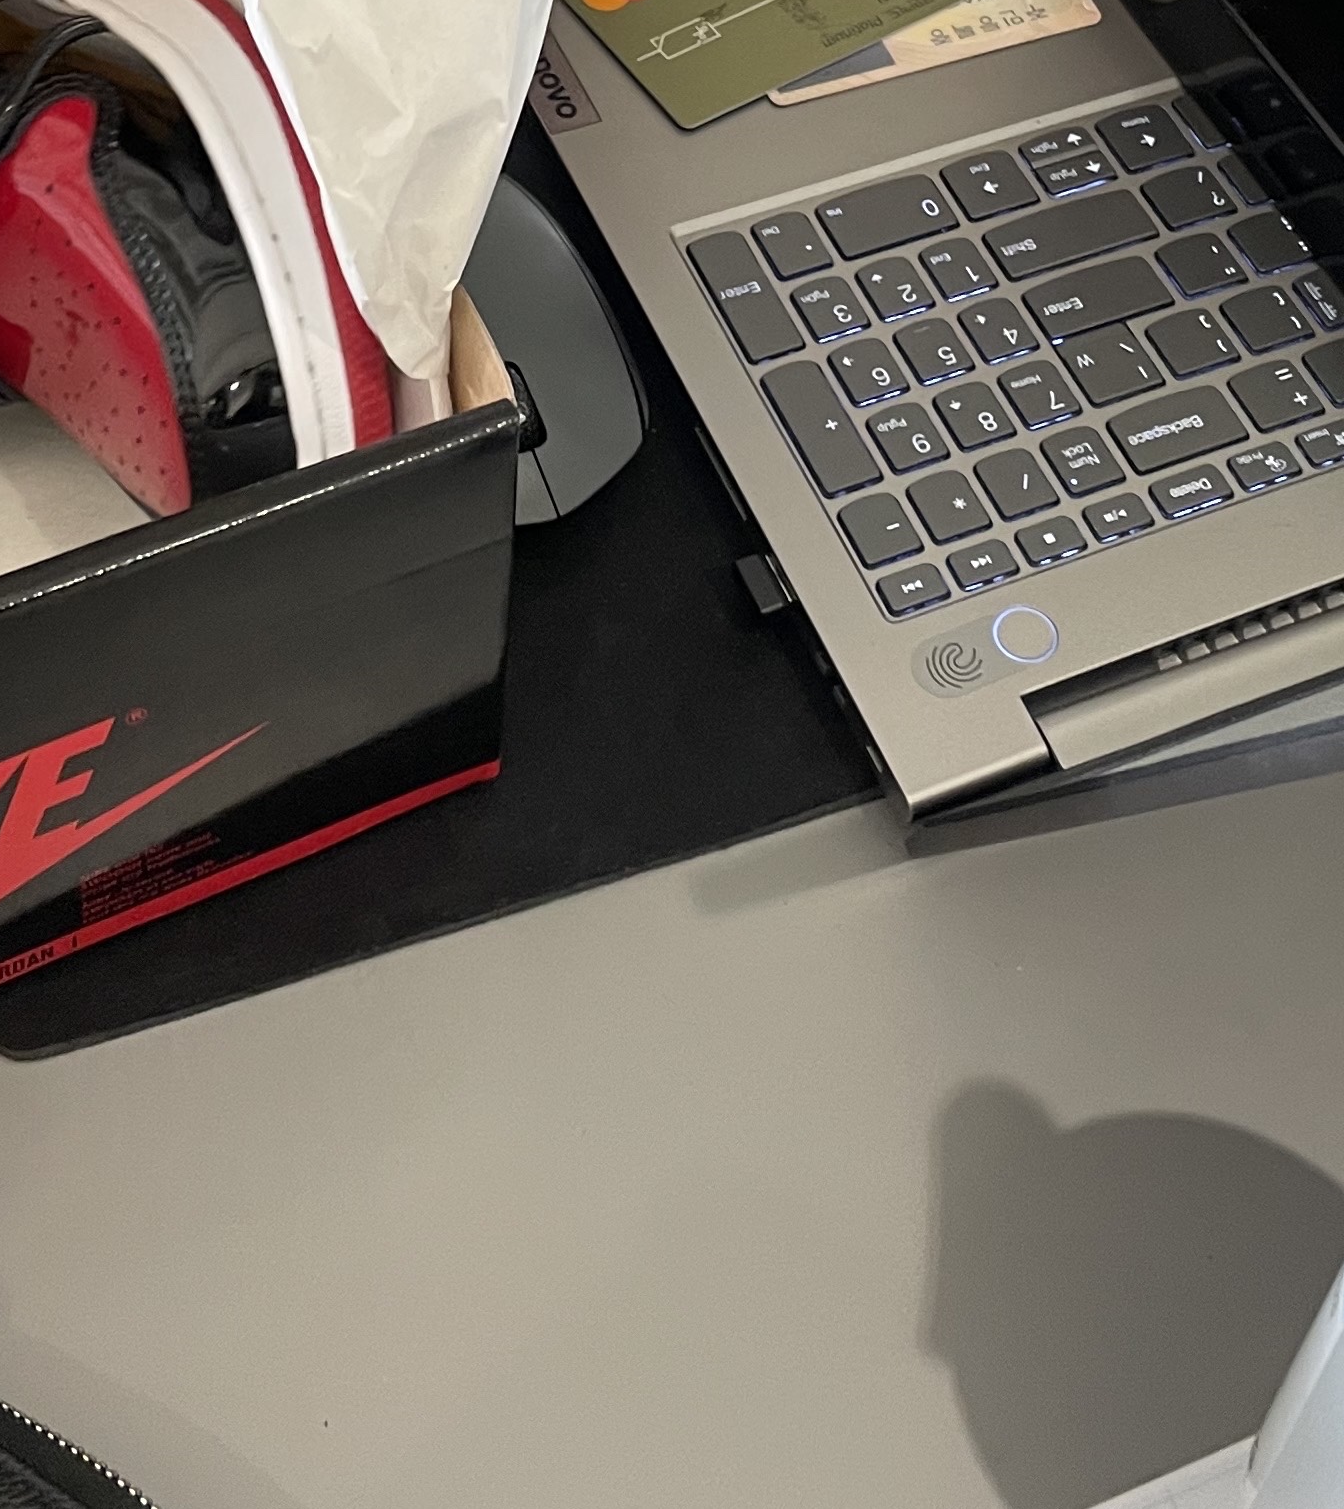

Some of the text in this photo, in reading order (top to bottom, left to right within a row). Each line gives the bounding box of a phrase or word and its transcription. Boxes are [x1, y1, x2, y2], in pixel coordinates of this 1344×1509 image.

[821, 15, 885, 48] Platinum
[1000, 238, 1038, 257] Shift
[720, 280, 761, 301] Enter
[896, 283, 918, 303] 2
[833, 304, 852, 324] 3
[1044, 296, 1084, 317] Enter
[1002, 327, 1018, 346] 4
[937, 345, 957, 366] 5
[871, 367, 891, 387] 6
[1049, 390, 1066, 410] 7
[977, 411, 998, 432] 8
[1127, 414, 1205, 447] Backspace
[912, 433, 932, 454] 9
[1061, 441, 1094, 459] Lock
[1068, 453, 1101, 470] Num
[1168, 477, 1213, 499] Delete
